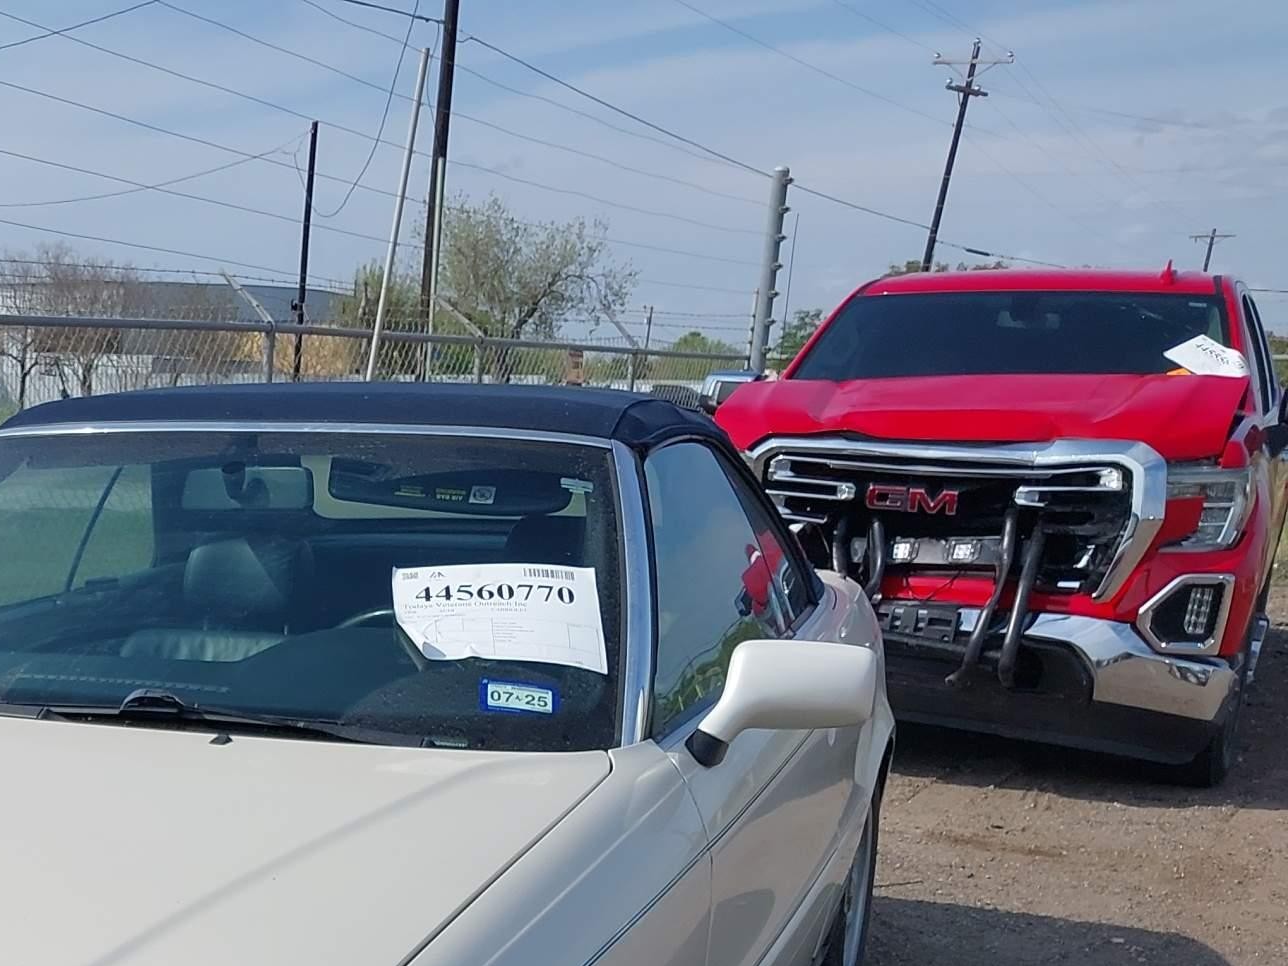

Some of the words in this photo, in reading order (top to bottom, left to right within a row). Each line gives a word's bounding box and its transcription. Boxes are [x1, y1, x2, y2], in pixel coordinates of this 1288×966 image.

[415, 583, 574, 604] 44560770
[490, 690, 514, 703] 07
[524, 694, 548, 708] 25
